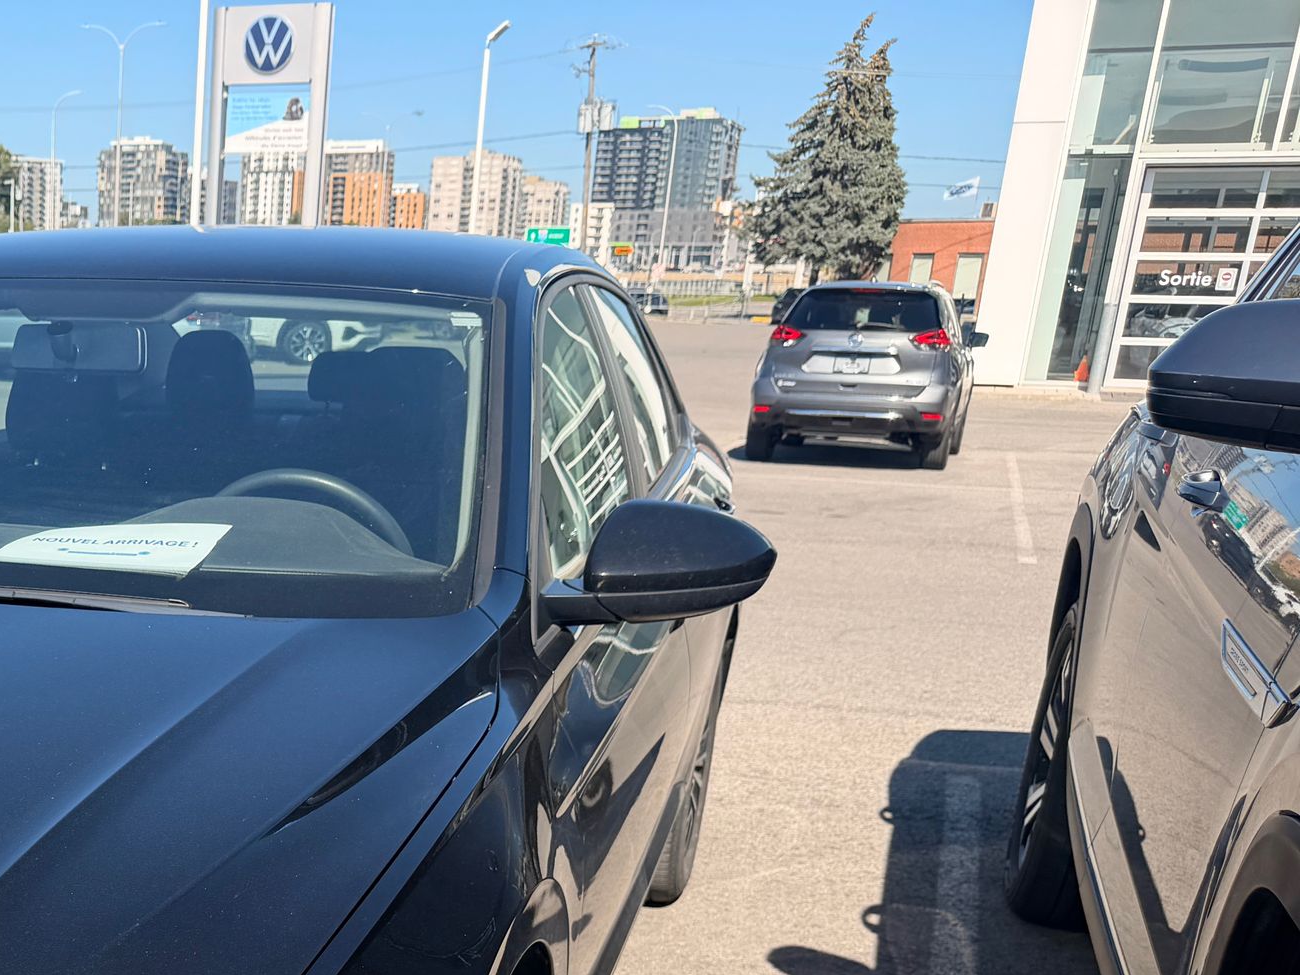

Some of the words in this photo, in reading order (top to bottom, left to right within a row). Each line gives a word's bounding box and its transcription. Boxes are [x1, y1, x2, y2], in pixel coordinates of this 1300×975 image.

[245, 15, 293, 72] VW
[1158, 269, 1213, 287] Sortie
[32, 536, 99, 546] NOUVEL
[102, 538, 188, 548] ARRIVAGE
